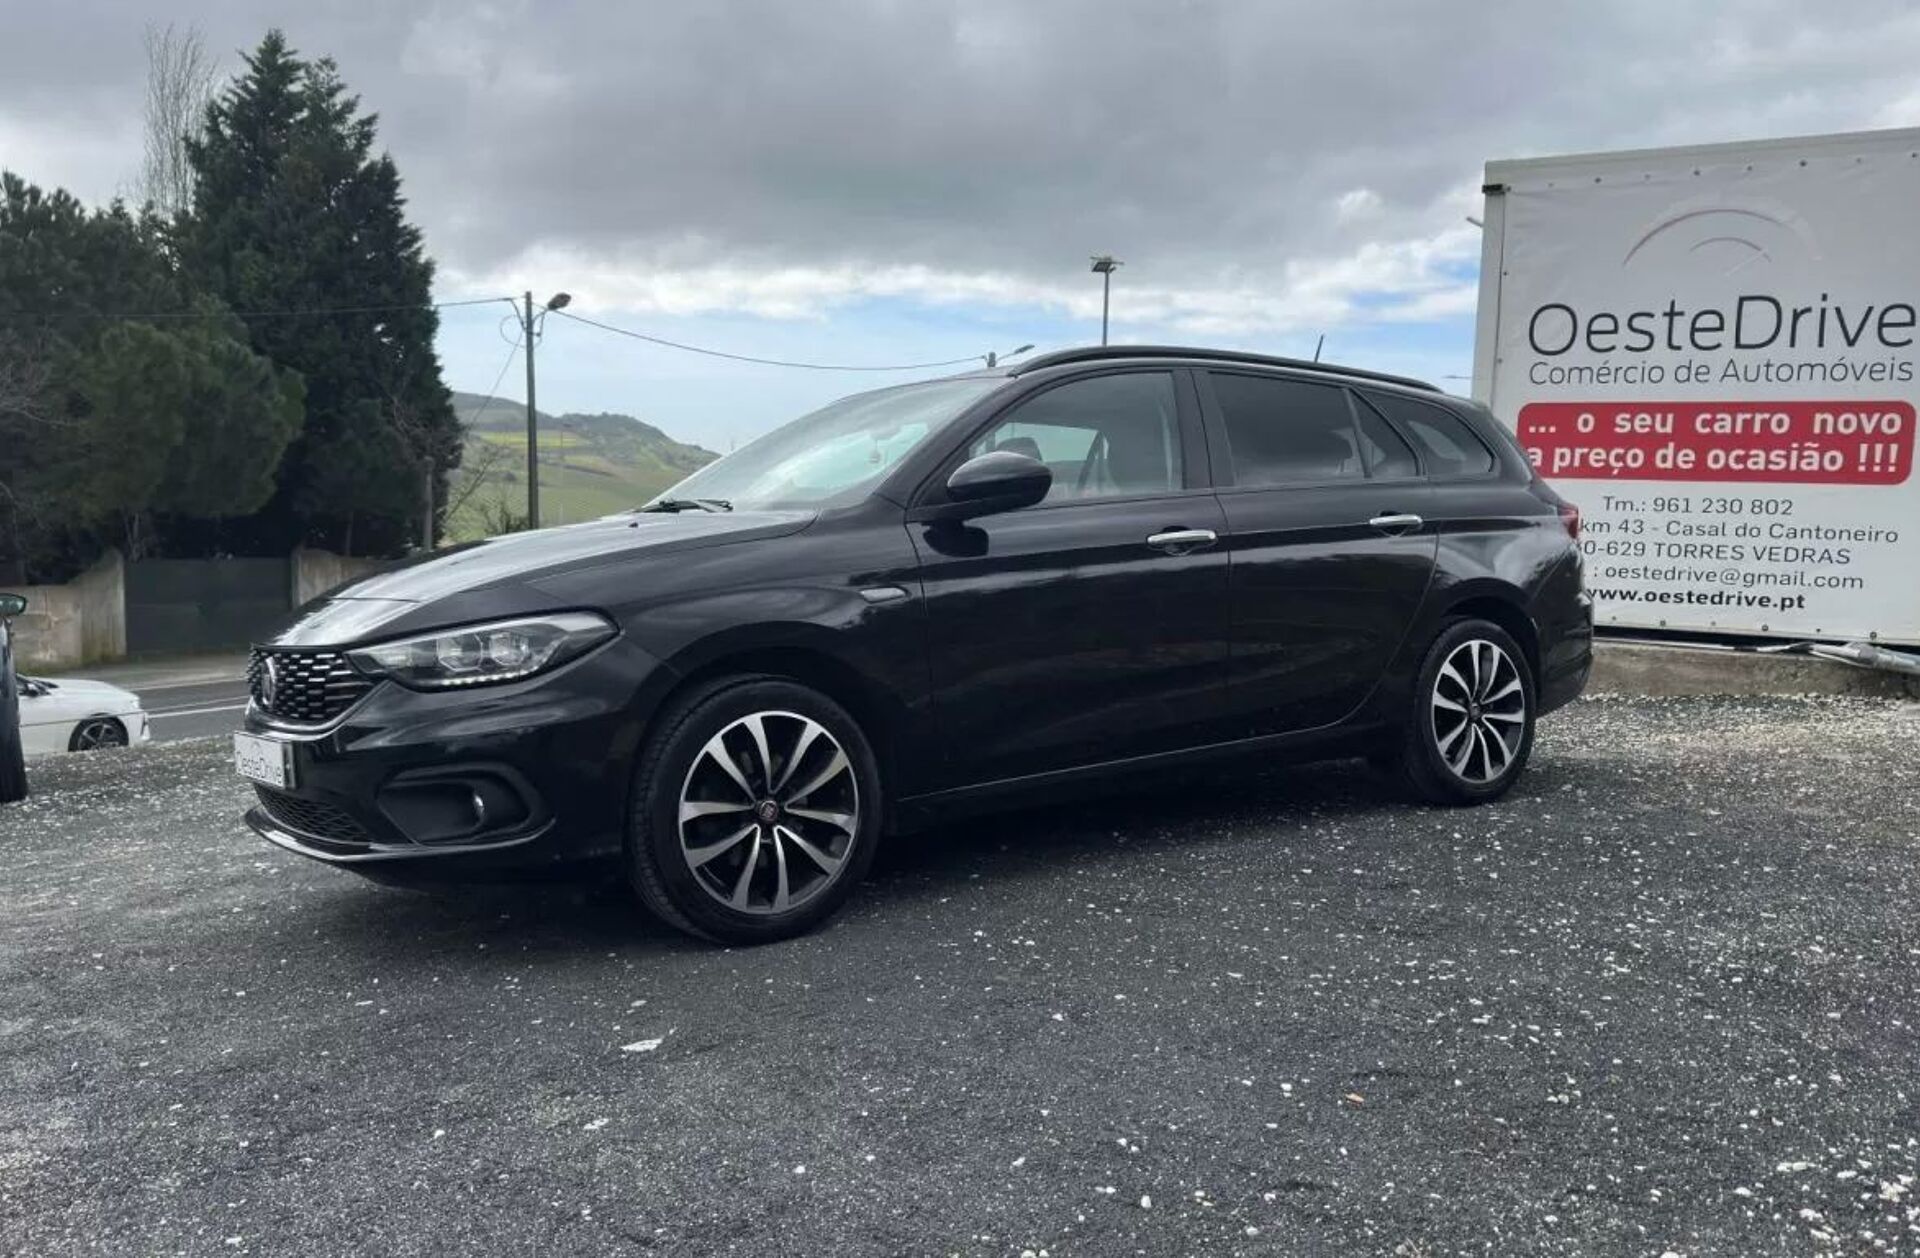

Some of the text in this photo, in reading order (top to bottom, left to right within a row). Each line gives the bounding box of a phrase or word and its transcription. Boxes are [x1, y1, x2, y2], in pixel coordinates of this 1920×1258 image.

[1528, 293, 1917, 356] OesteDrive
[1529, 356, 1914, 386] Comércio de Automóveis
[1576, 412, 1595, 434] o
[1613, 412, 1675, 434] seu
[1695, 411, 1791, 435] carro
[1813, 411, 1902, 436] novo
[1527, 441, 1899, 476] a preço de ocasião !!!
[1603, 495, 1794, 516] Tm.: 961 230 802
[1579, 517, 1611, 534] km
[1618, 518, 1645, 535] 43
[1666, 520, 1727, 538] Casal
[1735, 522, 1762, 539] do
[1769, 522, 1899, 544] Cantoneiro
[1577, 540, 1851, 565] 0-629 TORRES VEDRAS
[1605, 565, 1864, 589] oestedrive@gmail.com
